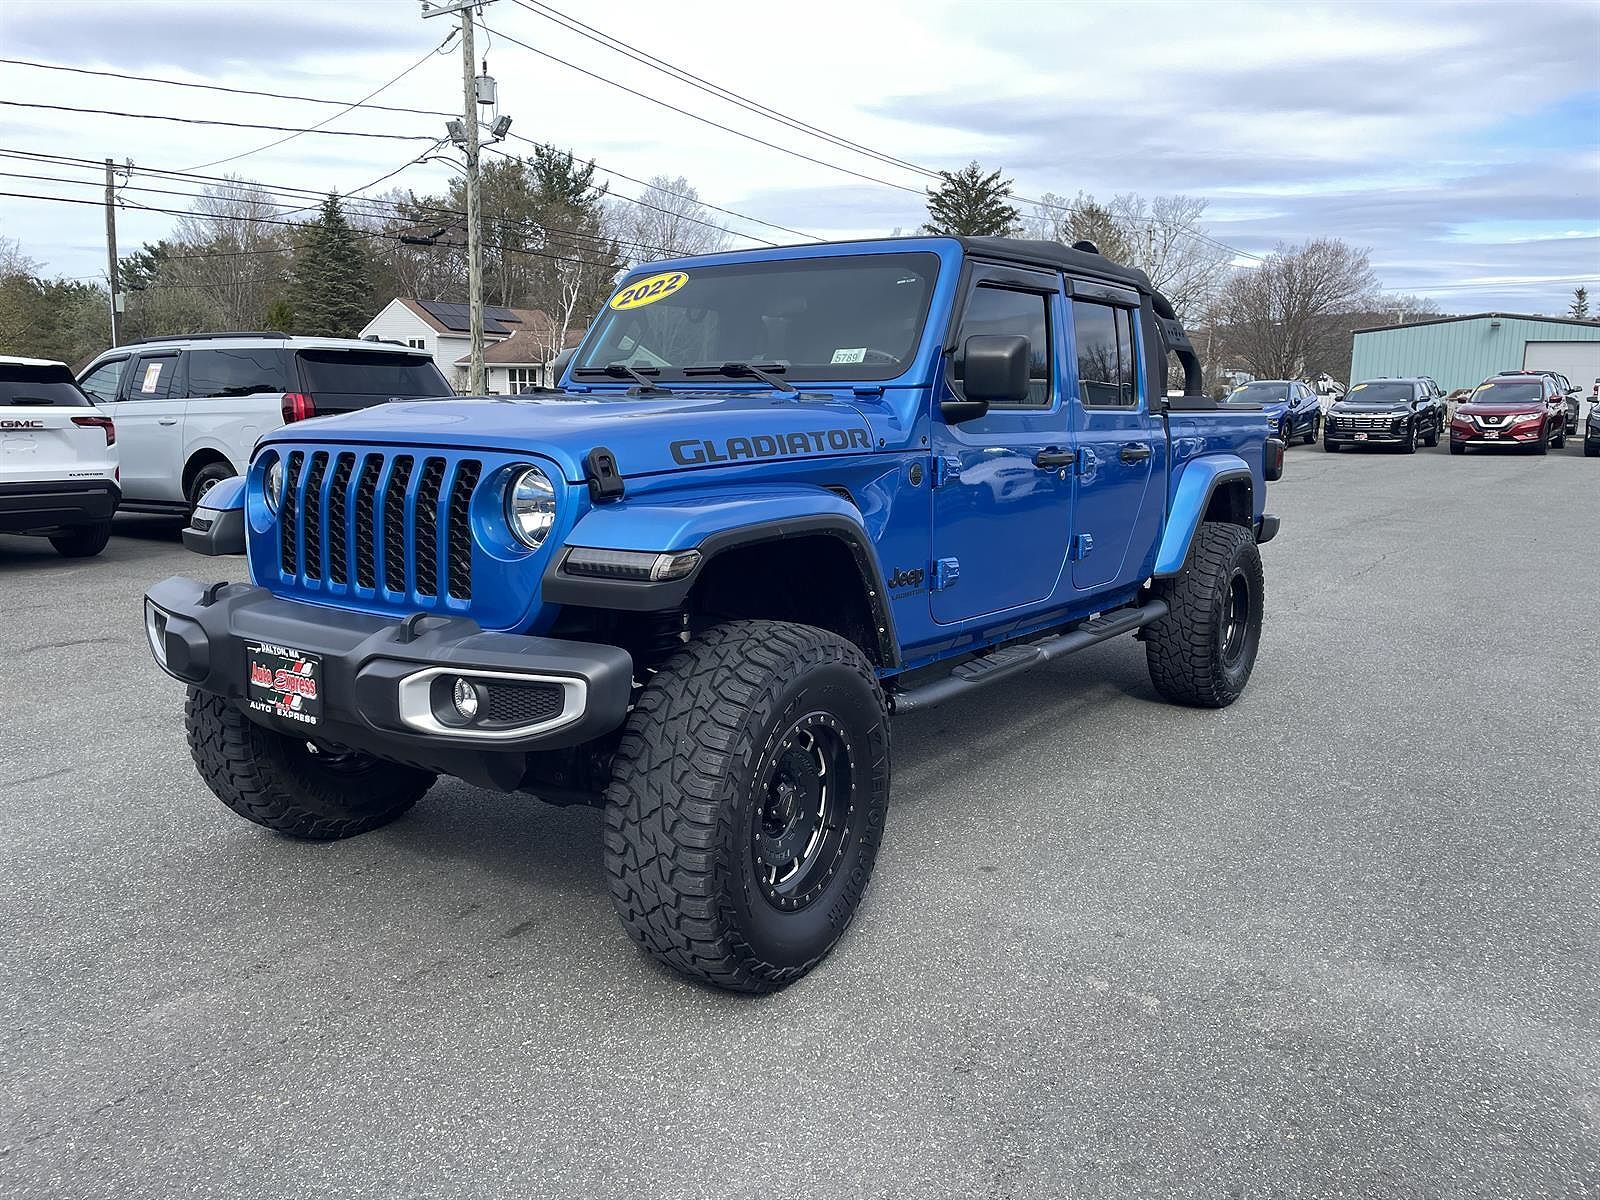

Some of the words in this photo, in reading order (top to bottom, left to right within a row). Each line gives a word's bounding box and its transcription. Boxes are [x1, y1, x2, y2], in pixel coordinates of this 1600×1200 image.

[617, 274, 682, 307] 2022
[835, 353, 858, 363] 5789
[0, 420, 44, 428] GMC
[669, 428, 872, 466] GLADIATOR
[888, 566, 925, 589] Jeep
[251, 661, 273, 687] Auto
[273, 668, 317, 698] Express
[250, 701, 272, 712] AUTO
[276, 709, 316, 723] EXPRESS
